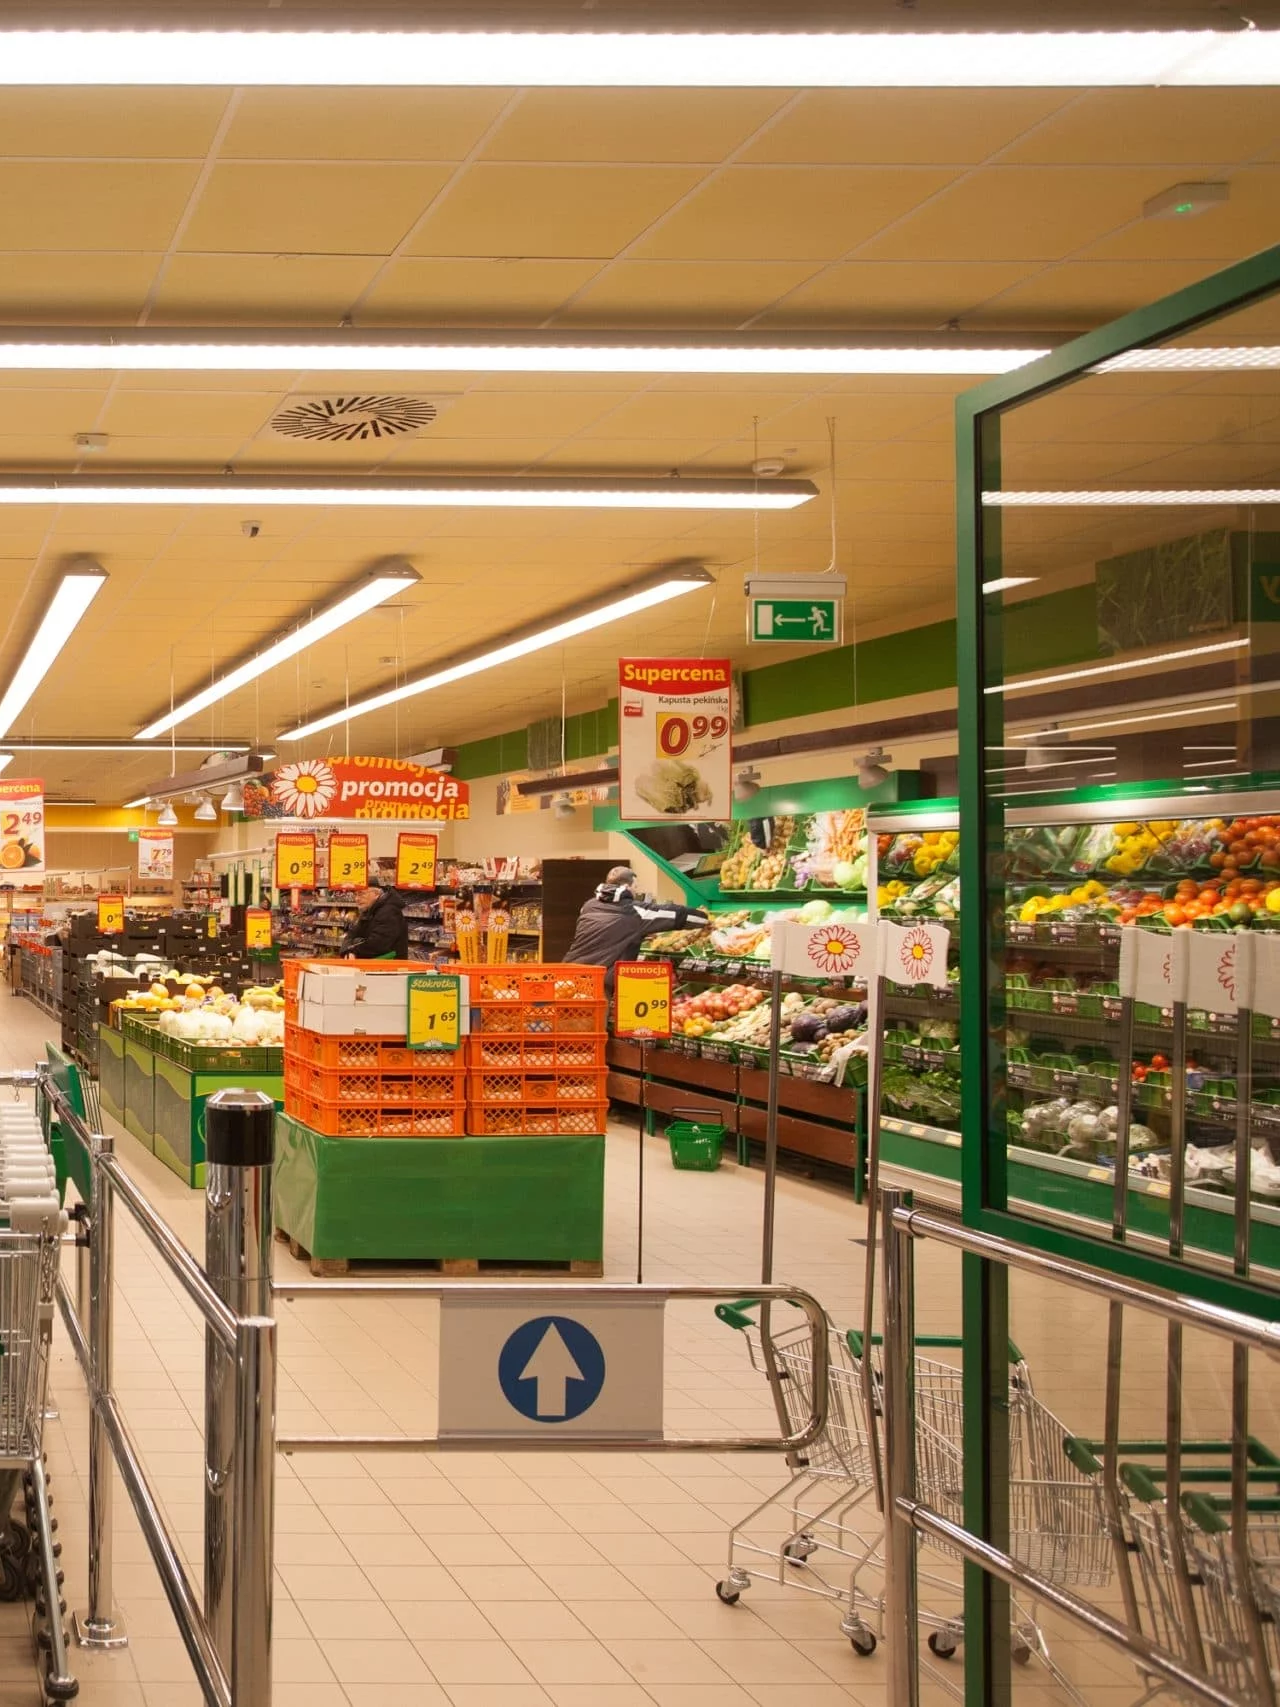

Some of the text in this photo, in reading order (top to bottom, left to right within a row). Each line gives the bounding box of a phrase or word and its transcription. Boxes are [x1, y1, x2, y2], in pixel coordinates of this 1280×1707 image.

[624, 664, 726, 686] Supercena
[658, 695, 729, 705] Kapusta pekińska
[341, 776, 459, 802] promocja
[620, 965, 667, 976] promocja
[411, 979, 456, 988] Stokrotka
